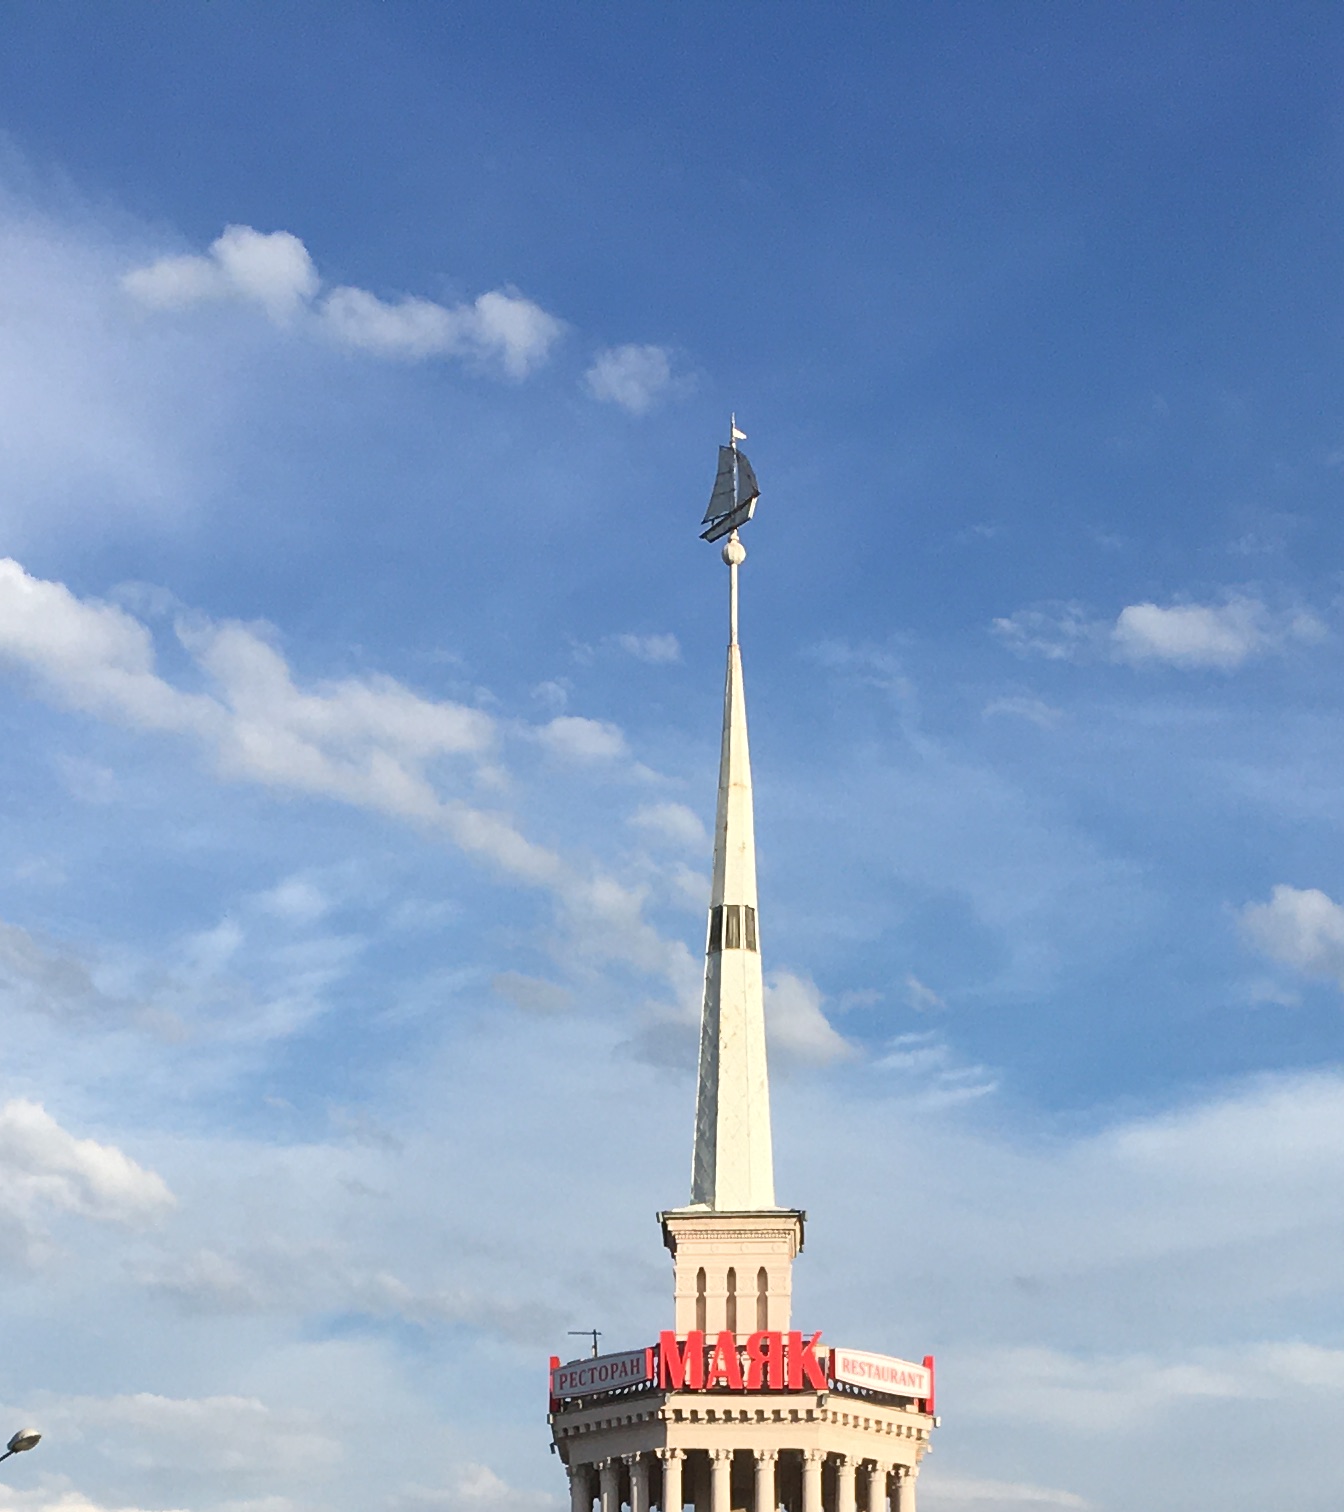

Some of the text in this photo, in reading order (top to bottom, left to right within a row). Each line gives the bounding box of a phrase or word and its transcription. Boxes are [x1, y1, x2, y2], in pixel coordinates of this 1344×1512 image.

[559, 1358, 641, 1390] РЕСТОРАН
[659, 1330, 829, 1390] МАЯК
[841, 1357, 925, 1390] RESTAURANT
